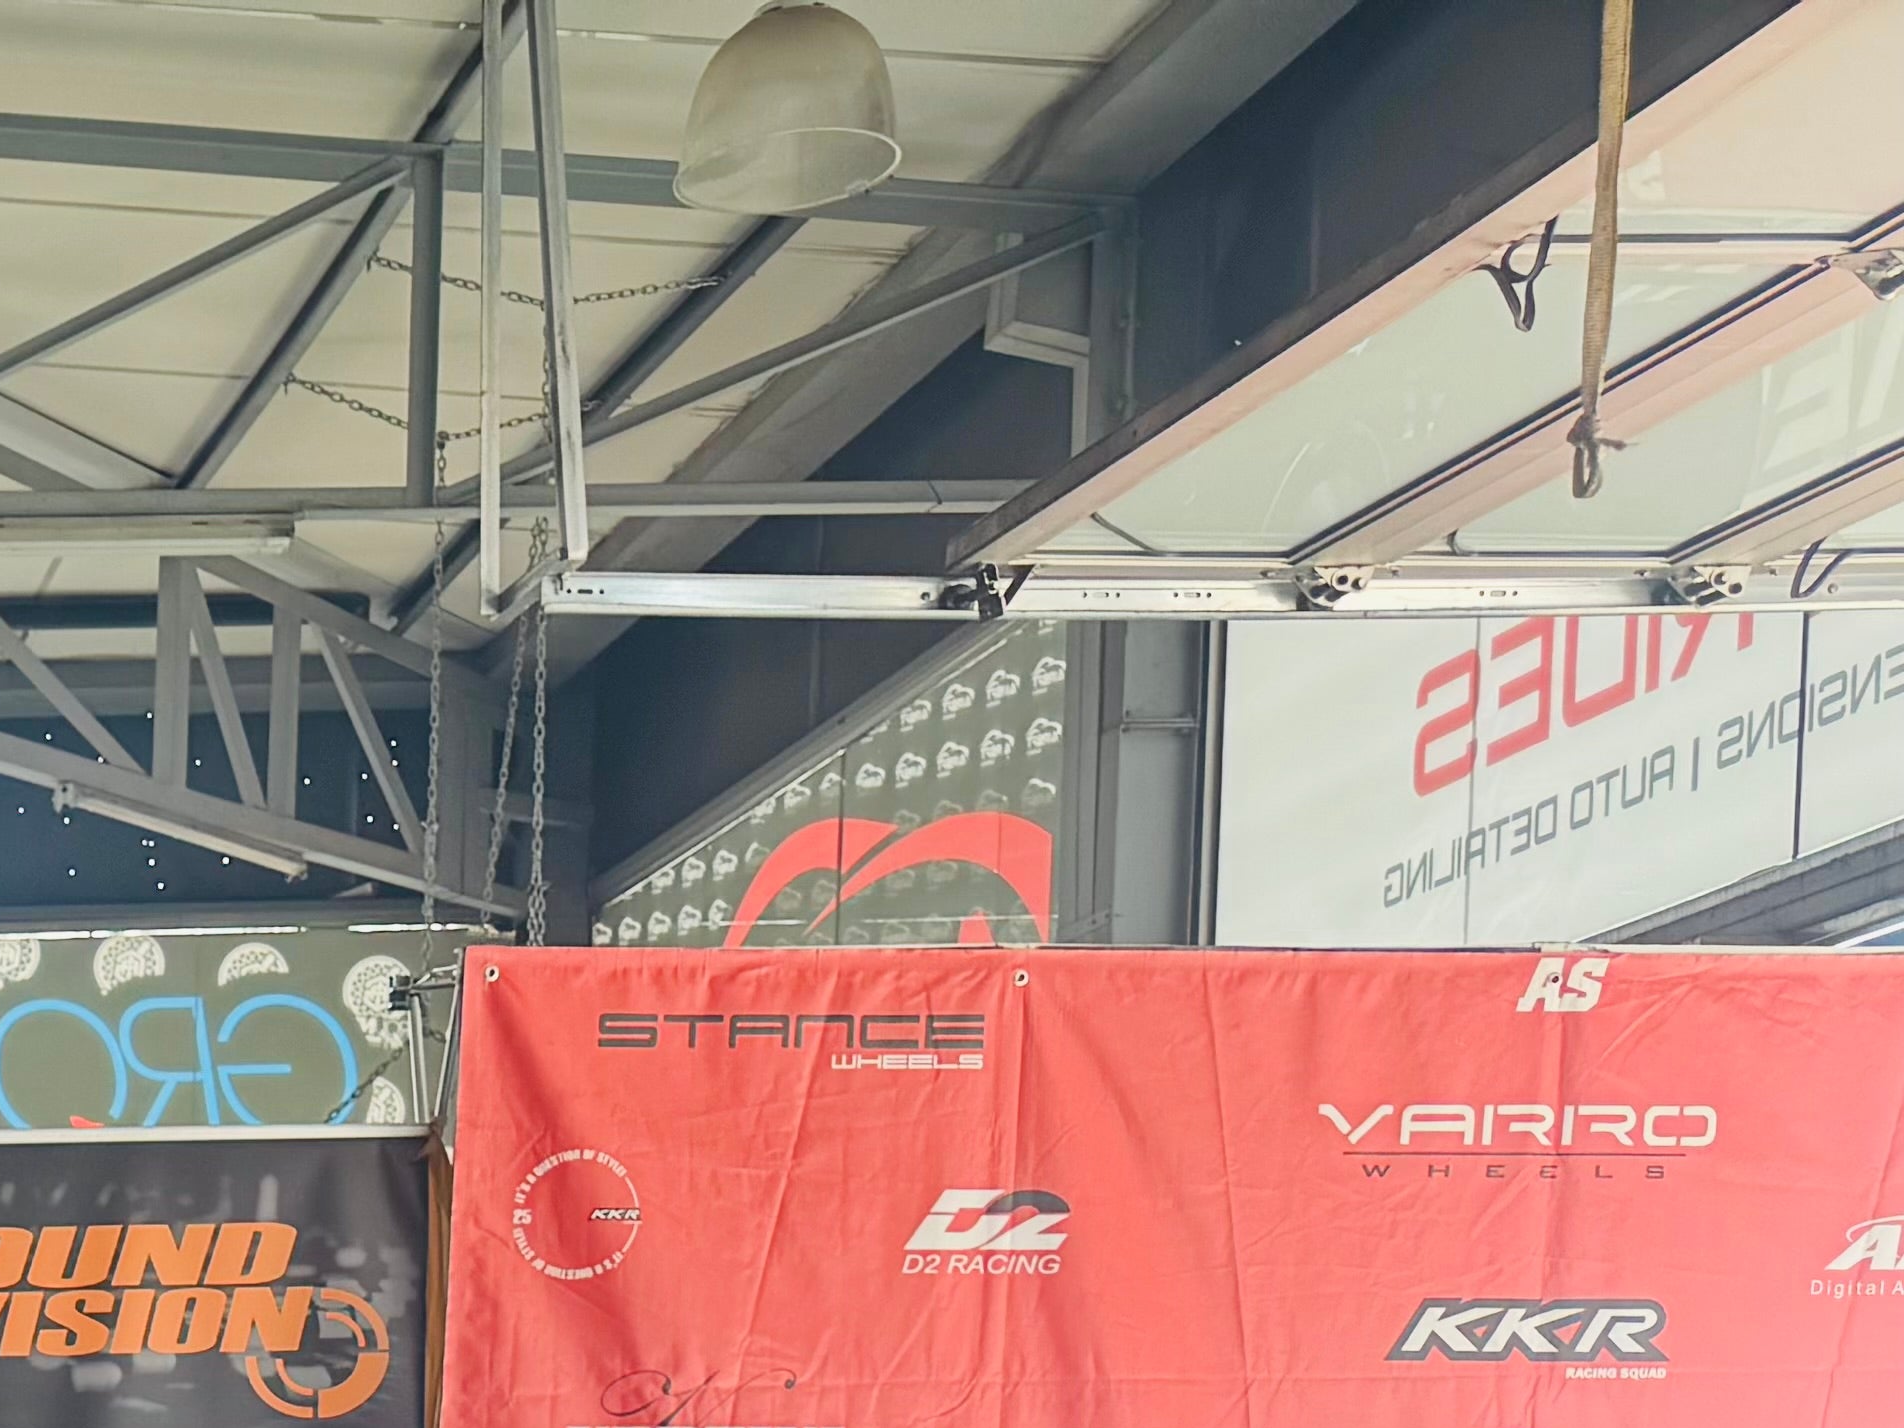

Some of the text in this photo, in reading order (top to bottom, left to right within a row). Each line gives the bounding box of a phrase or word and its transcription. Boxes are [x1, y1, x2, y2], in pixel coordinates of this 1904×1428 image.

[596, 1012, 986, 1049] STANCE
[830, 1053, 984, 1070] WHEELS
[1361, 1163, 1667, 1180] WHEELS
[901, 1254, 1062, 1276] D2 RACING
[1810, 1279, 1885, 1299] Digital
[1394, 1303, 1664, 1358] KKR
